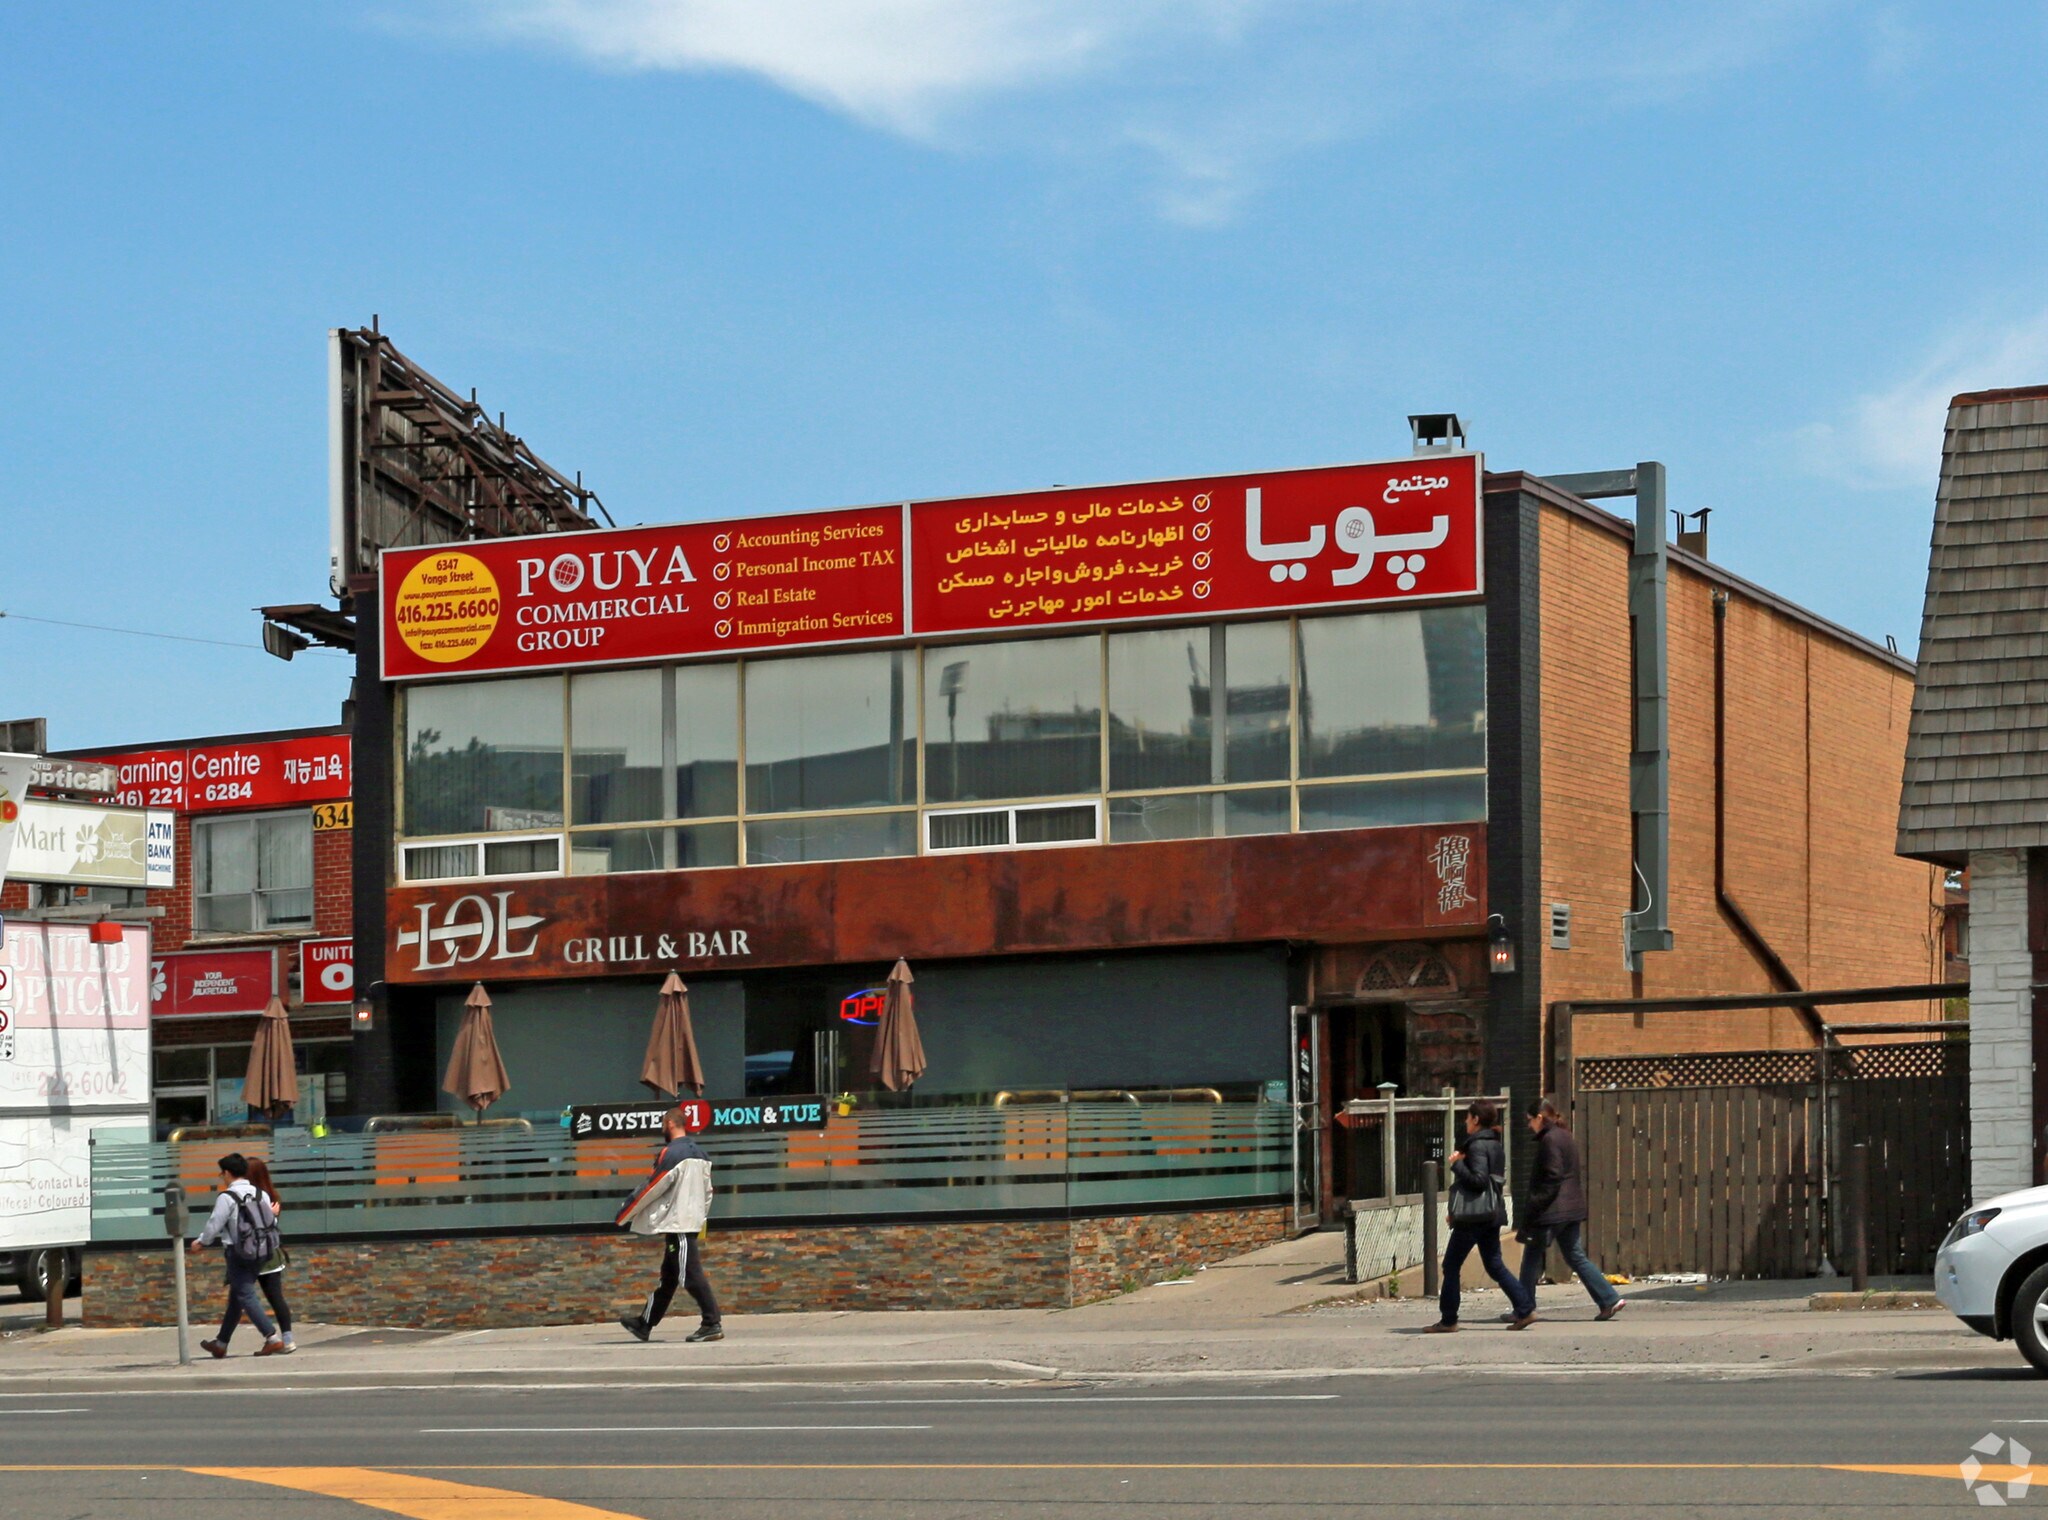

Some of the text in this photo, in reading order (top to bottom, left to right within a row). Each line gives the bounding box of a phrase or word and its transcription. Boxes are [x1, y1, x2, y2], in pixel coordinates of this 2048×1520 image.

[1383, 475, 1449, 503] مجتمع
[955, 496, 1184, 533] خدمات مالی و حسابداری
[736, 523, 884, 548] Accounting Services
[946, 525, 1184, 563] اظهارنامه مالیاتی اشخاص
[1246, 487, 1449, 591] پویا
[436, 559, 458, 571] 6347
[517, 545, 697, 597] POUYA
[736, 549, 895, 578] Personal Income TAX
[422, 571, 474, 585] Yonge Street
[938, 572, 994, 593] مسکن
[404, 586, 492, 600] www.pouyacommercial.com
[737, 587, 816, 607] Real Estate
[989, 585, 1184, 618] خدمات امور مهاجرتی
[397, 599, 499, 624] 416.225.6600
[516, 594, 690, 626] COMMERCIAL
[737, 610, 893, 637] Immigration Services
[517, 627, 605, 652] GROUP
[117, 751, 261, 785] arning Centre
[283, 754, 342, 785] 재능교육
[149, 787, 183, 806] 221
[205, 781, 252, 801] 6284
[313, 804, 351, 830] 634
[16, 821, 66, 852] Mart
[148, 822, 172, 840] ATM
[148, 844, 172, 860] BANK
[412, 891, 538, 972] LOL
[563, 930, 751, 963] GRILL & BAR
[204, 971, 222, 980] YOUR
[38, 1071, 127, 1096] 222-6002
[599, 1111, 668, 1131] OYSTE
[684, 1105, 700, 1127] $1
[714, 1106, 760, 1125] MON
[763, 1107, 777, 1124] &
[779, 1104, 821, 1122] TUE
[30, 1175, 73, 1190] Contact
[0, 1194, 85, 1210] ifocal Coloured
